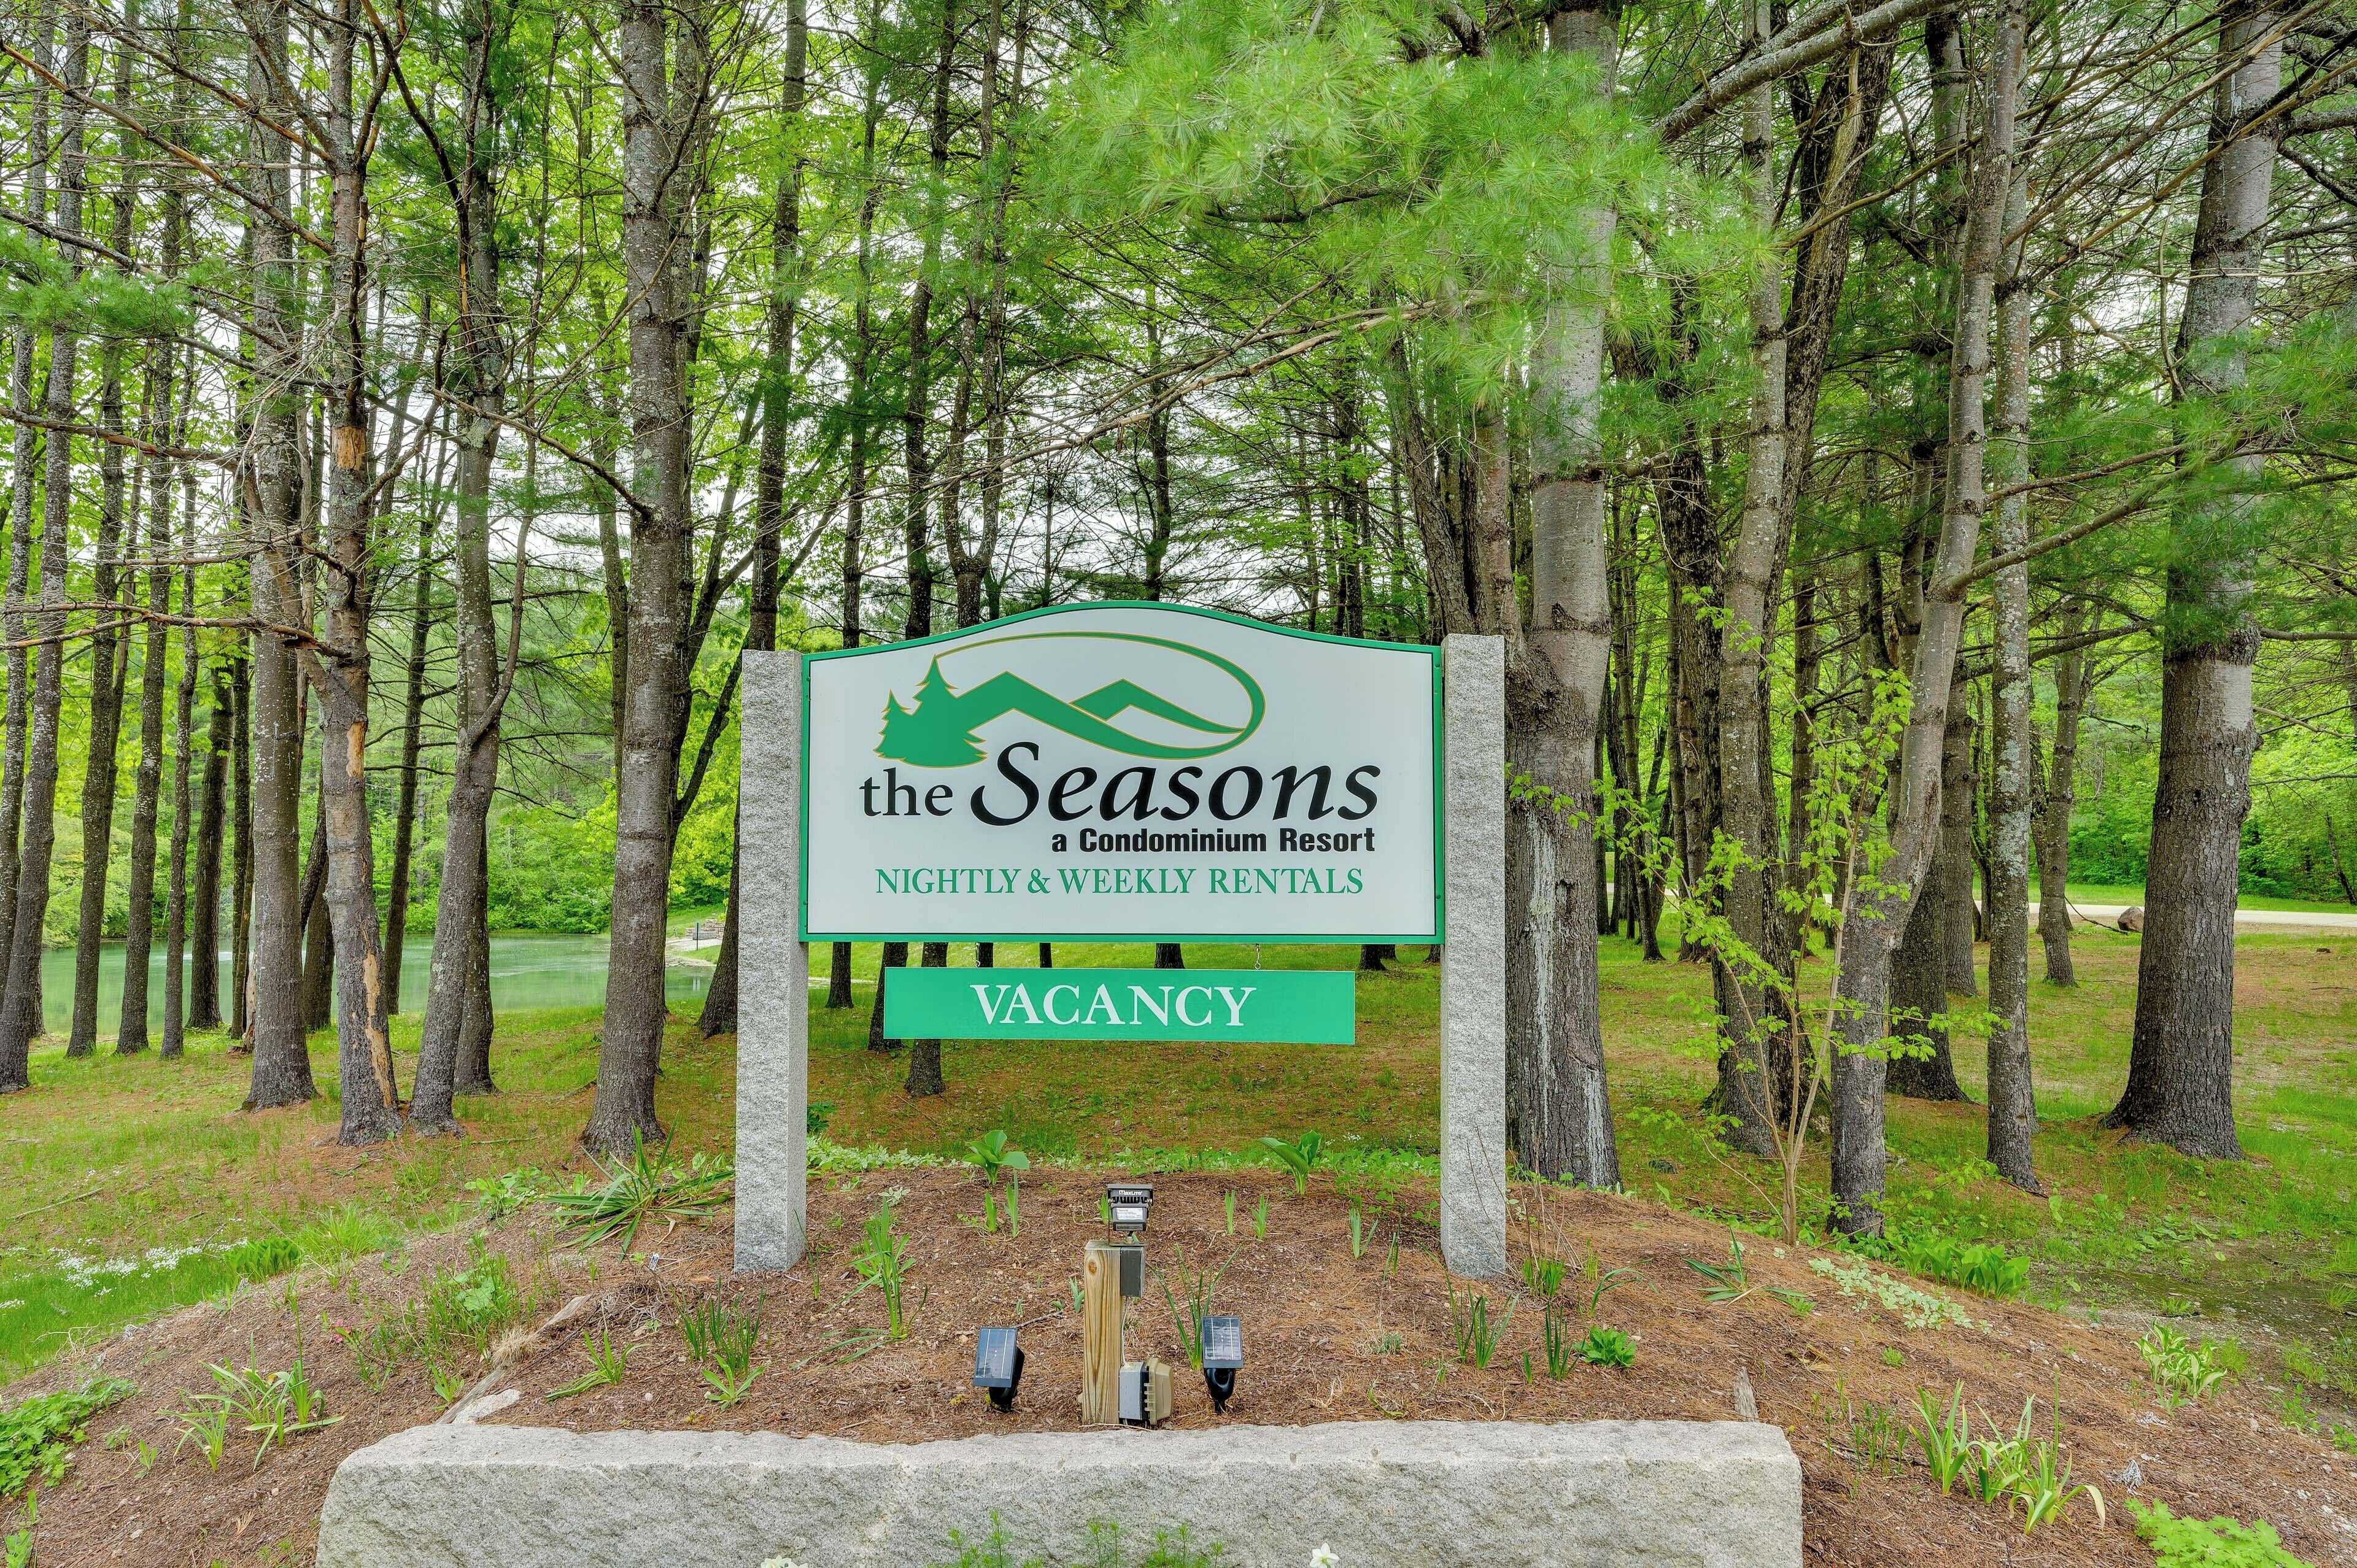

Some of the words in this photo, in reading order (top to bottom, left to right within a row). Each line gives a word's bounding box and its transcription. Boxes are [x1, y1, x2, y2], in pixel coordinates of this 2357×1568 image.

[859, 767, 953, 817] the
[970, 741, 1381, 826] Seasons
[1051, 833, 1067, 852] a
[1080, 828, 1267, 852] Condominium
[1280, 827, 1375, 852] Resort
[875, 868, 1021, 894] NIGHTLY
[1027, 868, 1051, 894] &
[1057, 868, 1196, 894] WEEKLY
[1209, 867, 1363, 894] RENTALS
[971, 983, 1256, 1026] VACANCY
